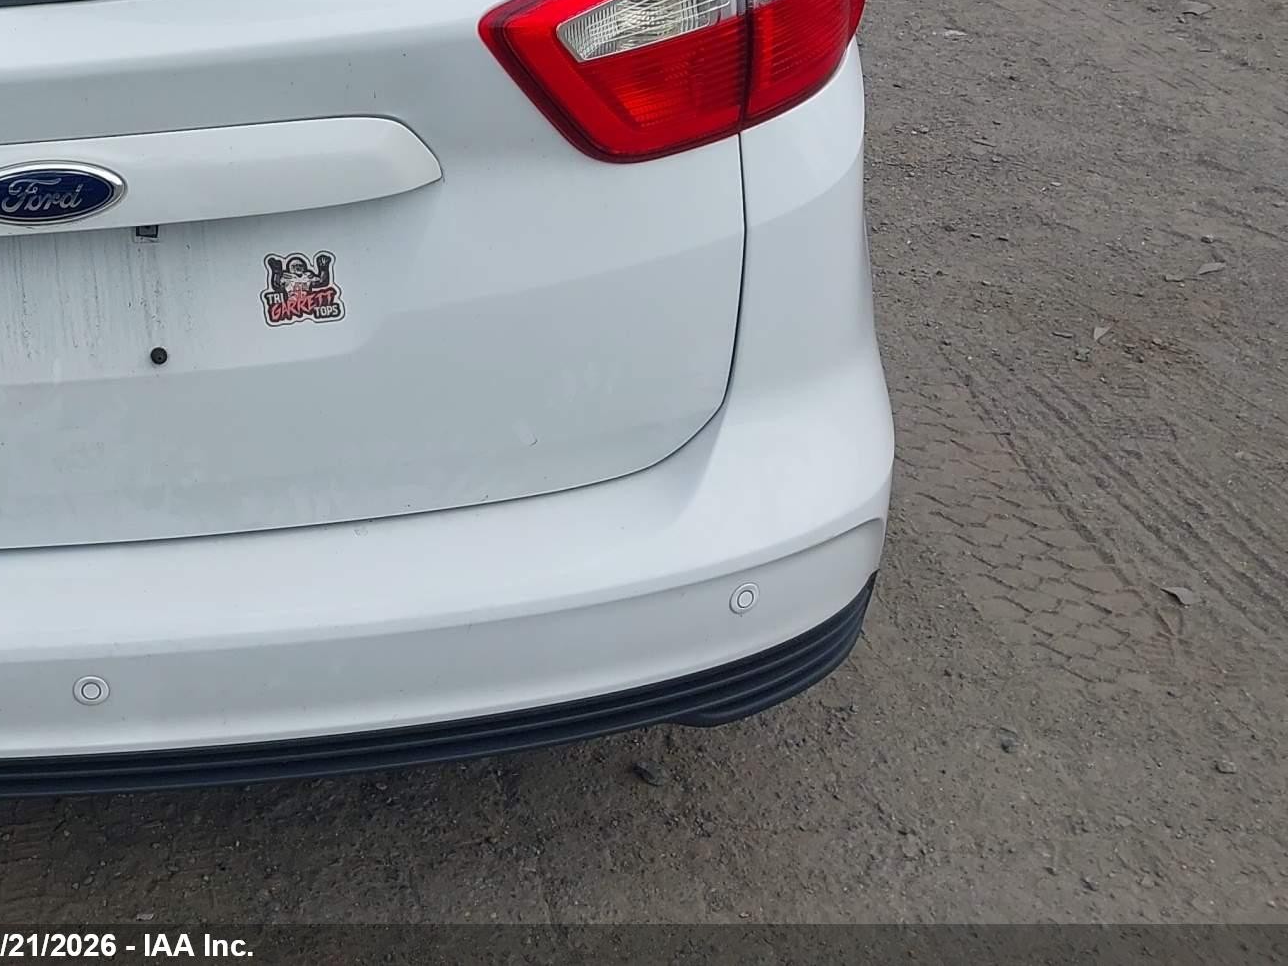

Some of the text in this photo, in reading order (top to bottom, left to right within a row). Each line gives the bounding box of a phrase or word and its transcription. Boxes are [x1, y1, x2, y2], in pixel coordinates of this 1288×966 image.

[1, 177, 84, 213] Ford
[271, 290, 335, 320] GARRETT
[314, 304, 339, 317] TOPS
